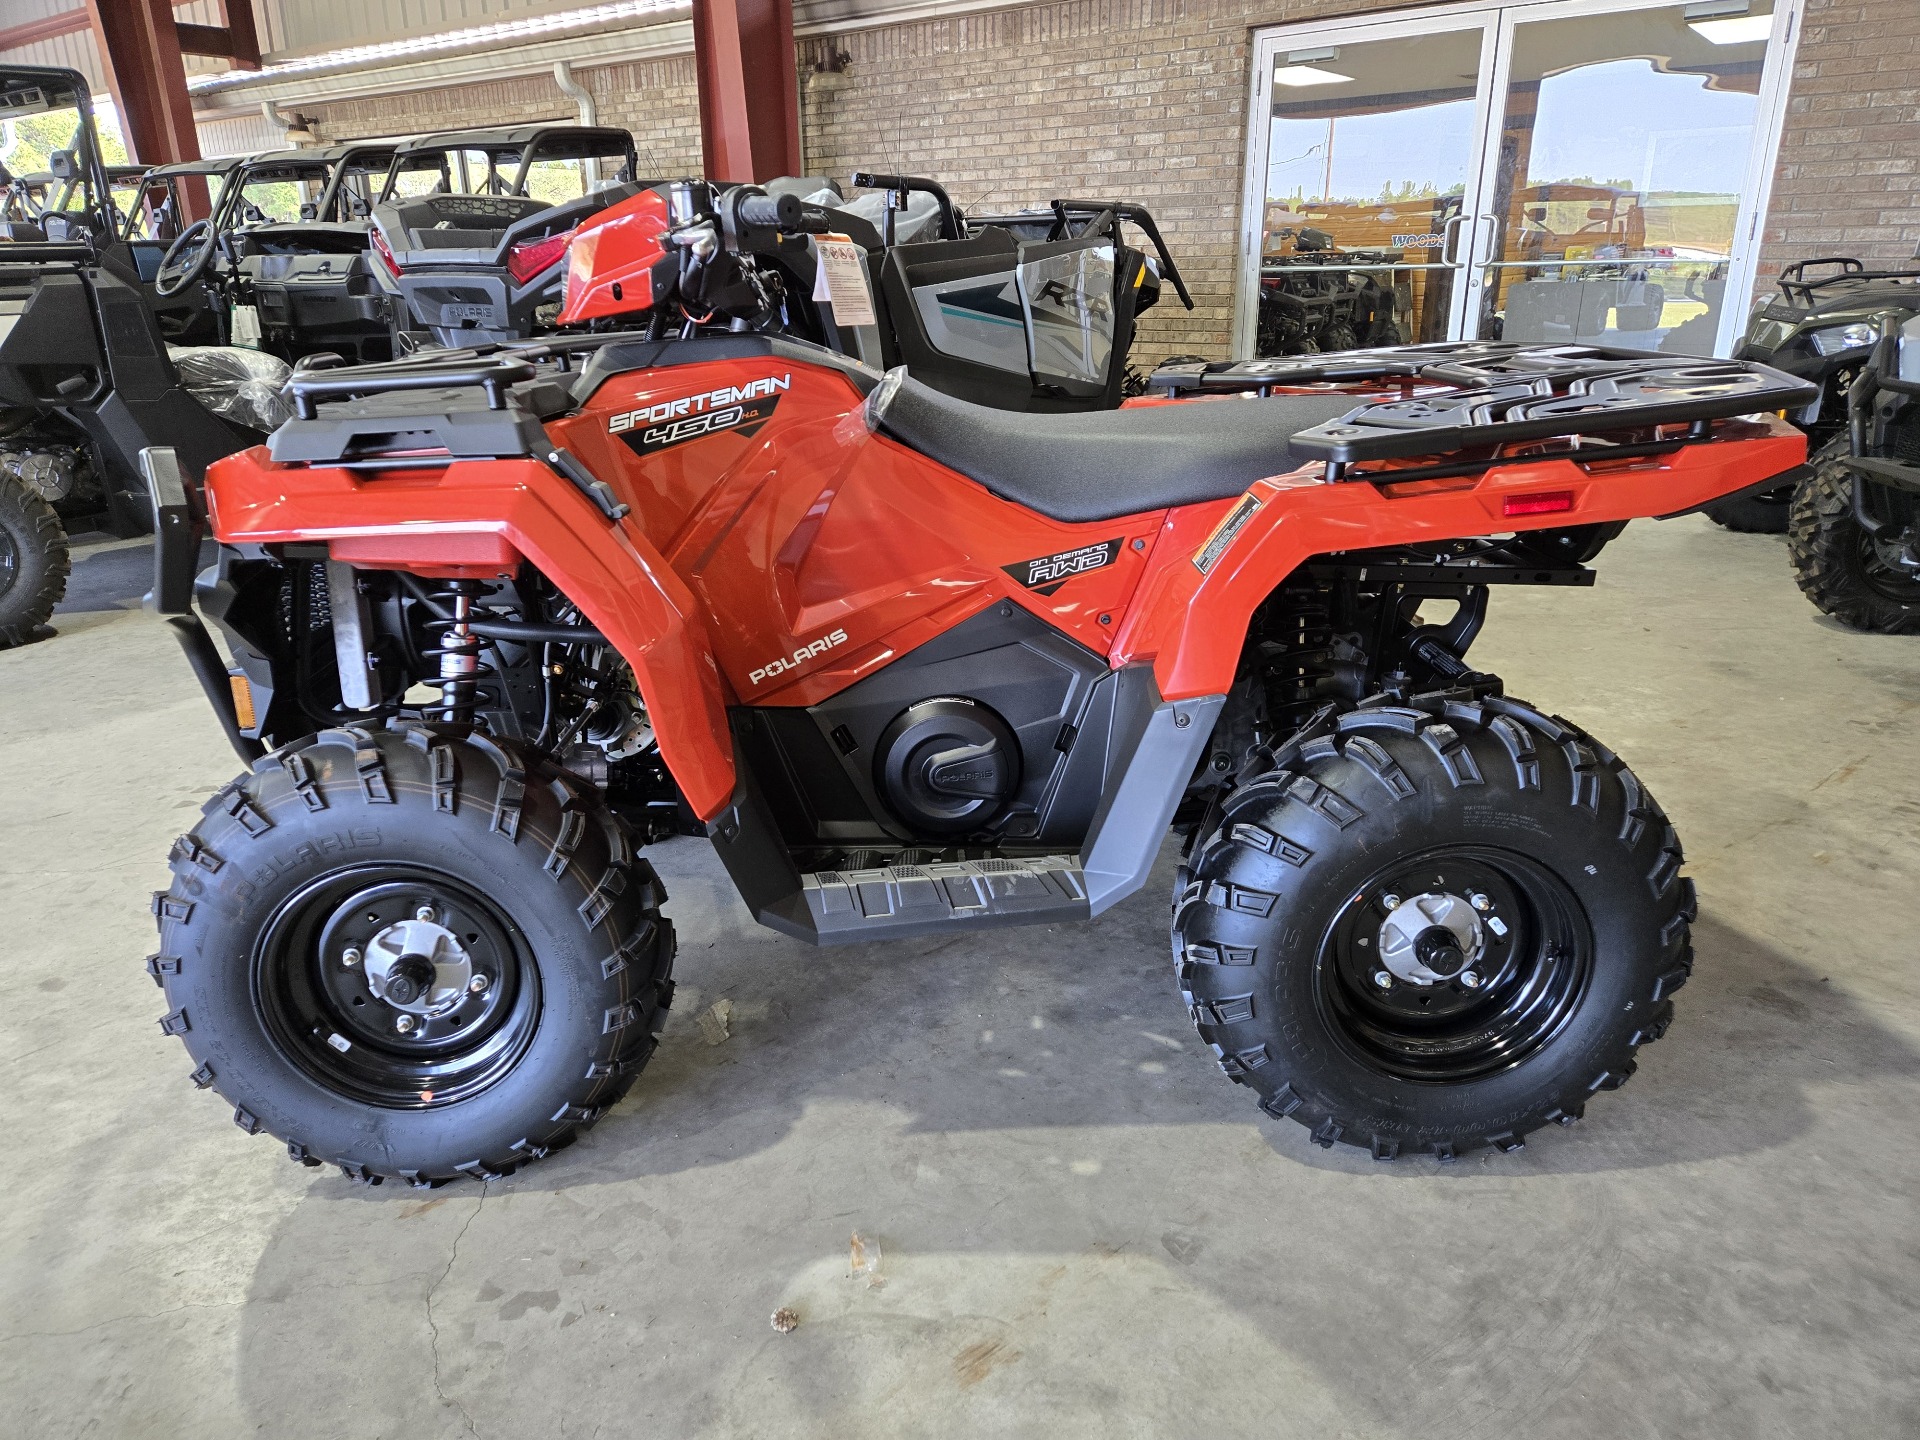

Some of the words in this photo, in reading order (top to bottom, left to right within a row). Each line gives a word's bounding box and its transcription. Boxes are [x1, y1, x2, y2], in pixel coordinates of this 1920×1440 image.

[448, 307, 492, 318] POLARIS
[608, 373, 791, 434] SPORTSMAN
[644, 405, 744, 444] 450
[1028, 550, 1108, 584] AWD
[1053, 543, 1109, 562] DEMAND
[748, 628, 848, 685] POLARIS
[941, 769, 994, 783] POLARIS
[234, 825, 383, 908] POLARIS
